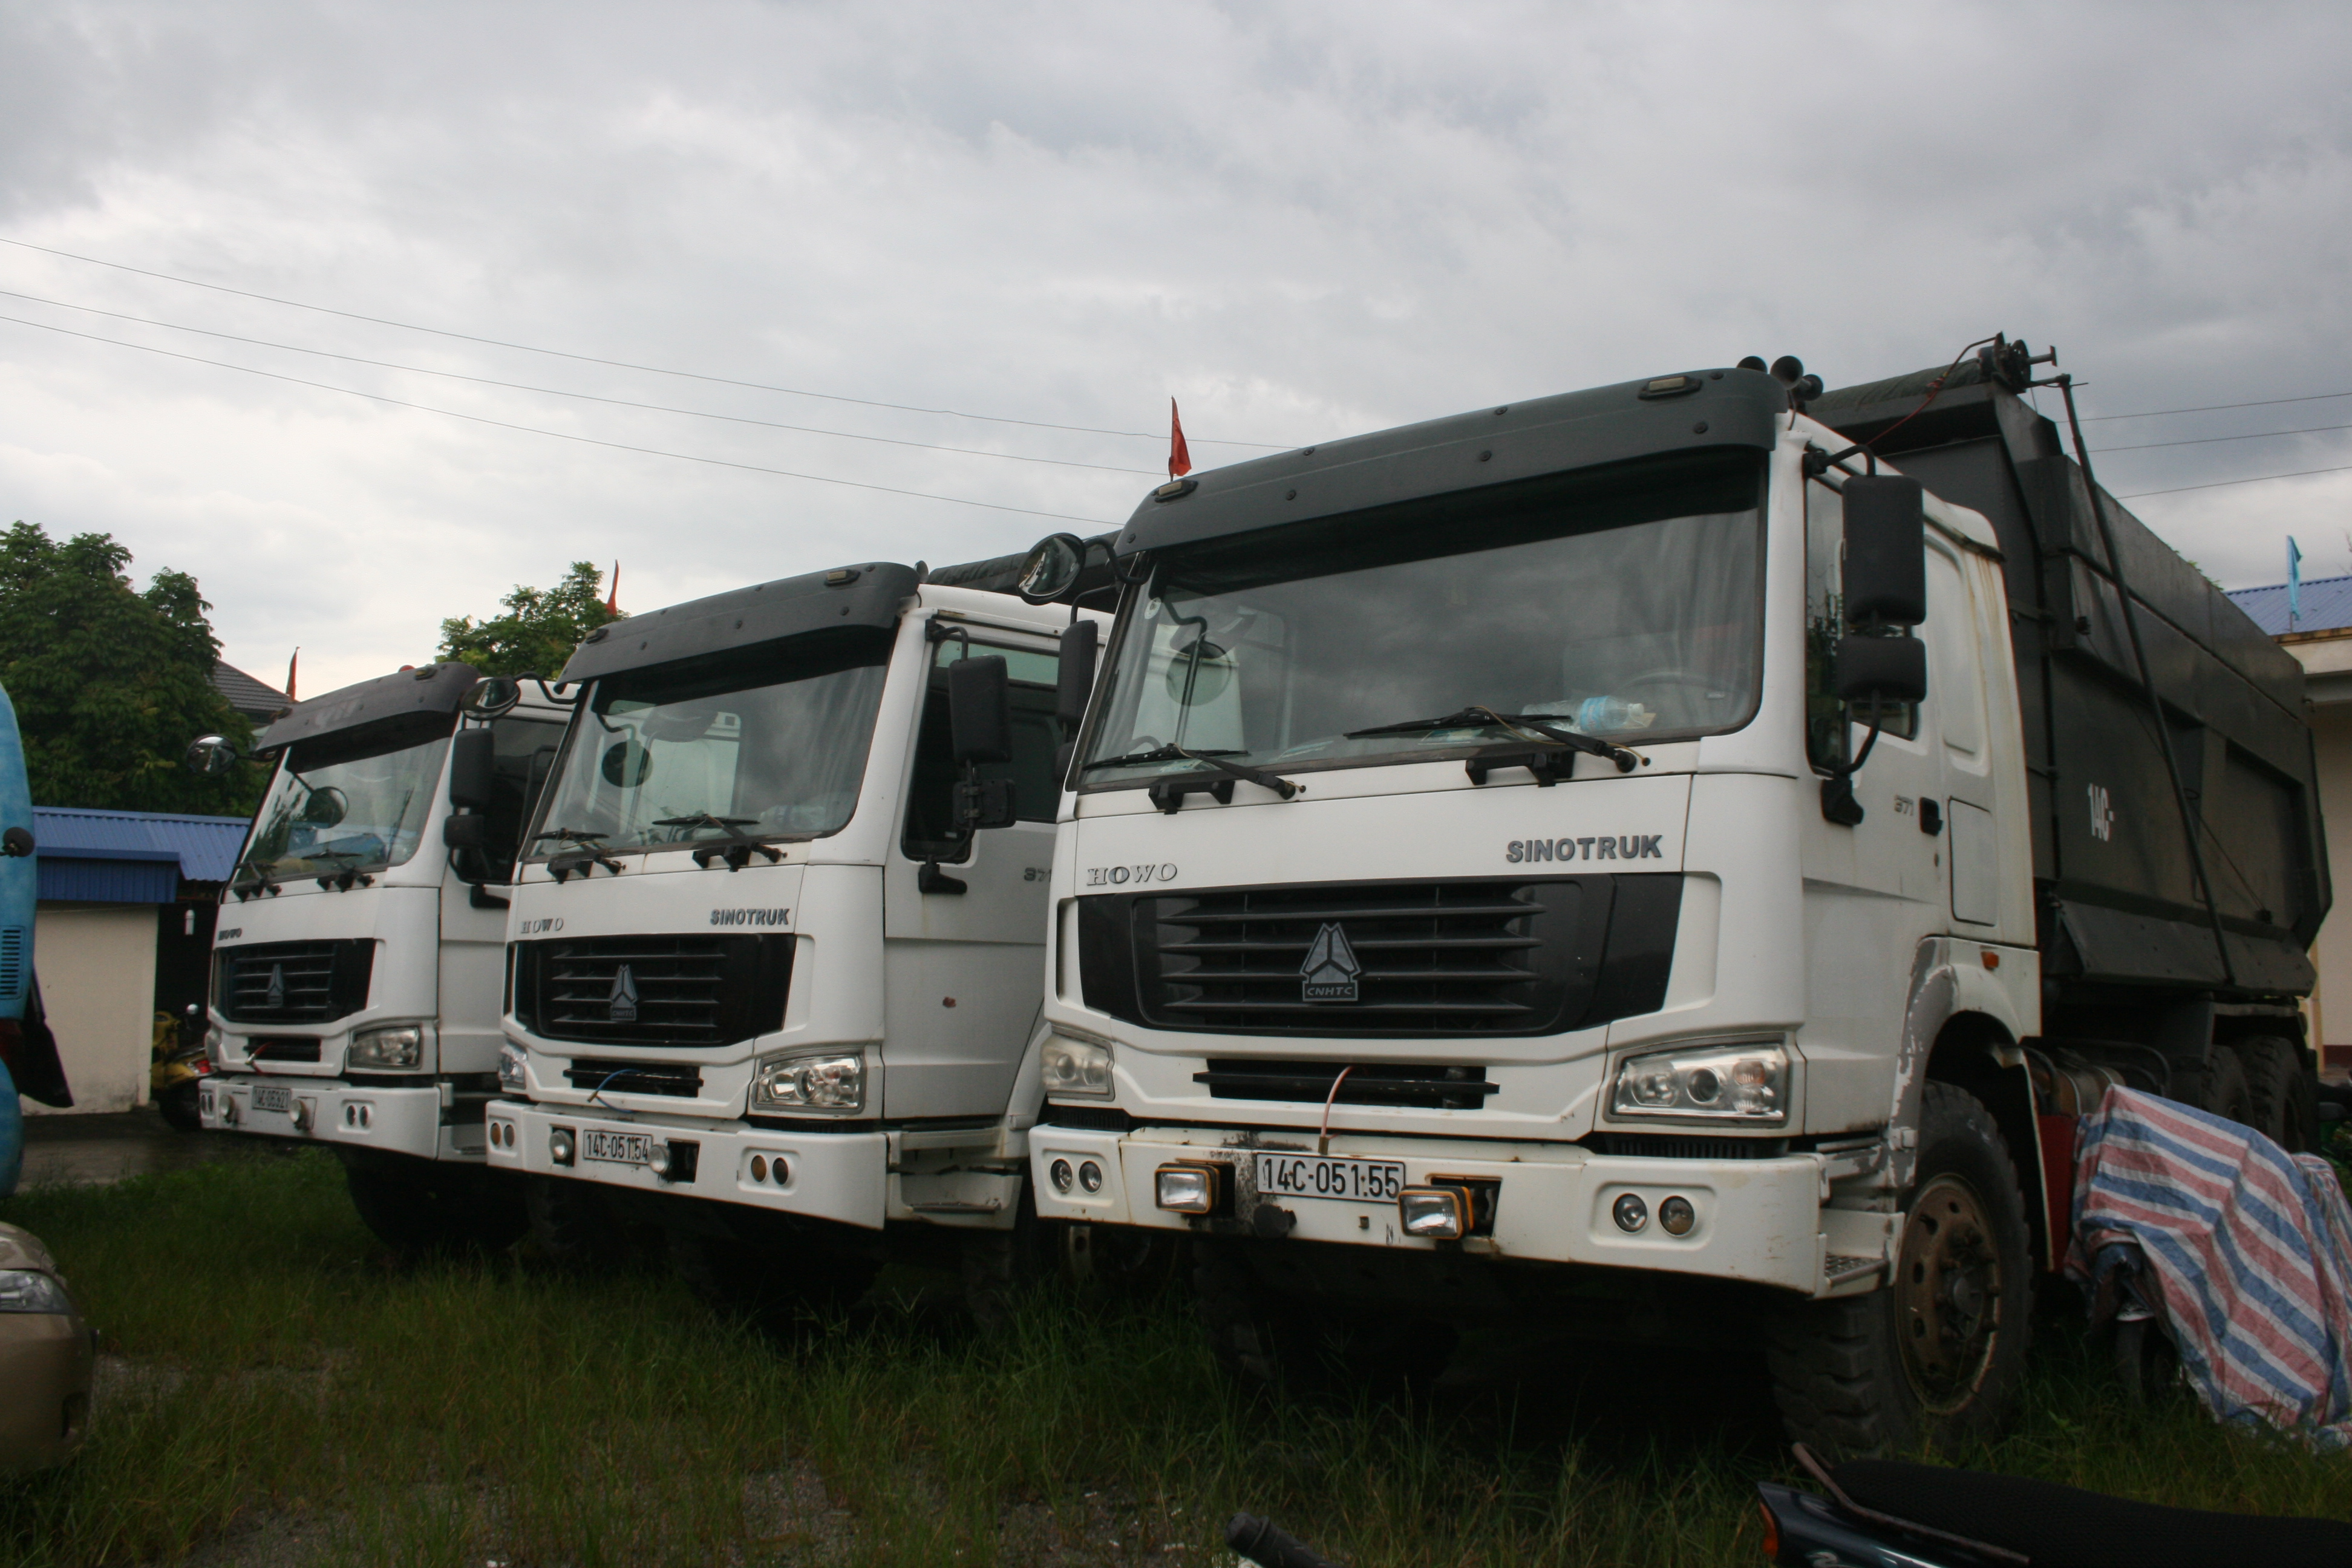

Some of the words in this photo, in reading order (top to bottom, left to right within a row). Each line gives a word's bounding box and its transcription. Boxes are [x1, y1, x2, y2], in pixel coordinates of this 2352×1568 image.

[1506, 835, 1662, 863] SINOTRUK
[1086, 863, 1177, 886] HOWO
[520, 918, 563, 933] HOWO
[710, 909, 789, 926] SINOTRUK
[1307, 987, 1353, 996] CNHTC
[1264, 1158, 1399, 1198] 14C-051.55
